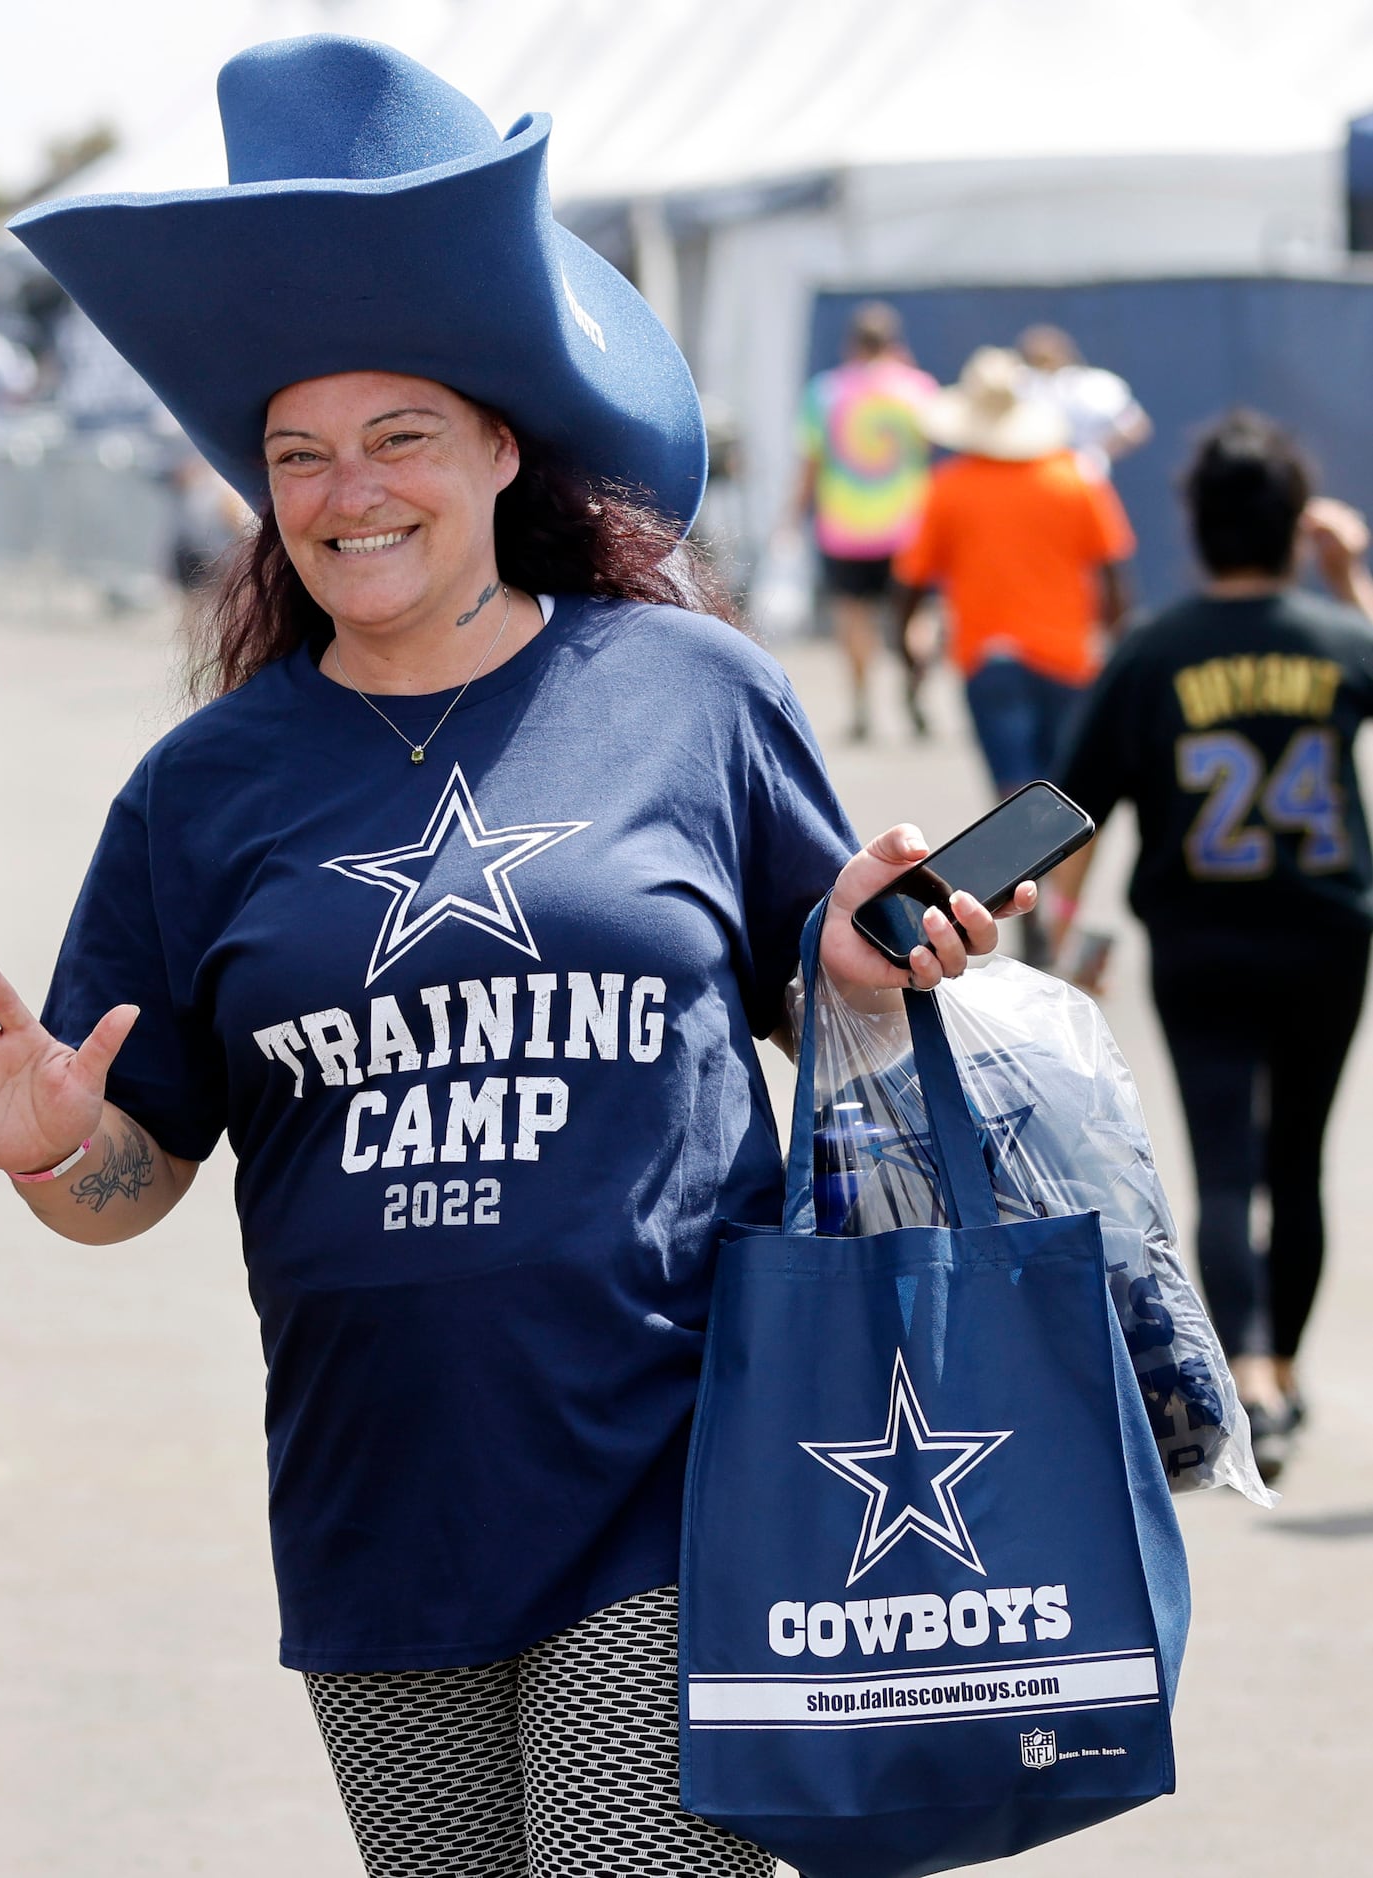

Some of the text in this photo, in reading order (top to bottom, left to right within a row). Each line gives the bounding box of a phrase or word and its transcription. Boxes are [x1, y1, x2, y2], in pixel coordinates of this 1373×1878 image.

[1175, 728, 1350, 880] 24
[253, 972, 667, 1098] TRAINING
[341, 1077, 569, 1174] CAMP
[383, 1178, 501, 1231] 2022
[768, 1585, 1072, 1657] COWBOYS
[806, 1676, 1060, 1713] shop.dallascowboys.com
[1026, 1747, 1052, 1763] NFL
